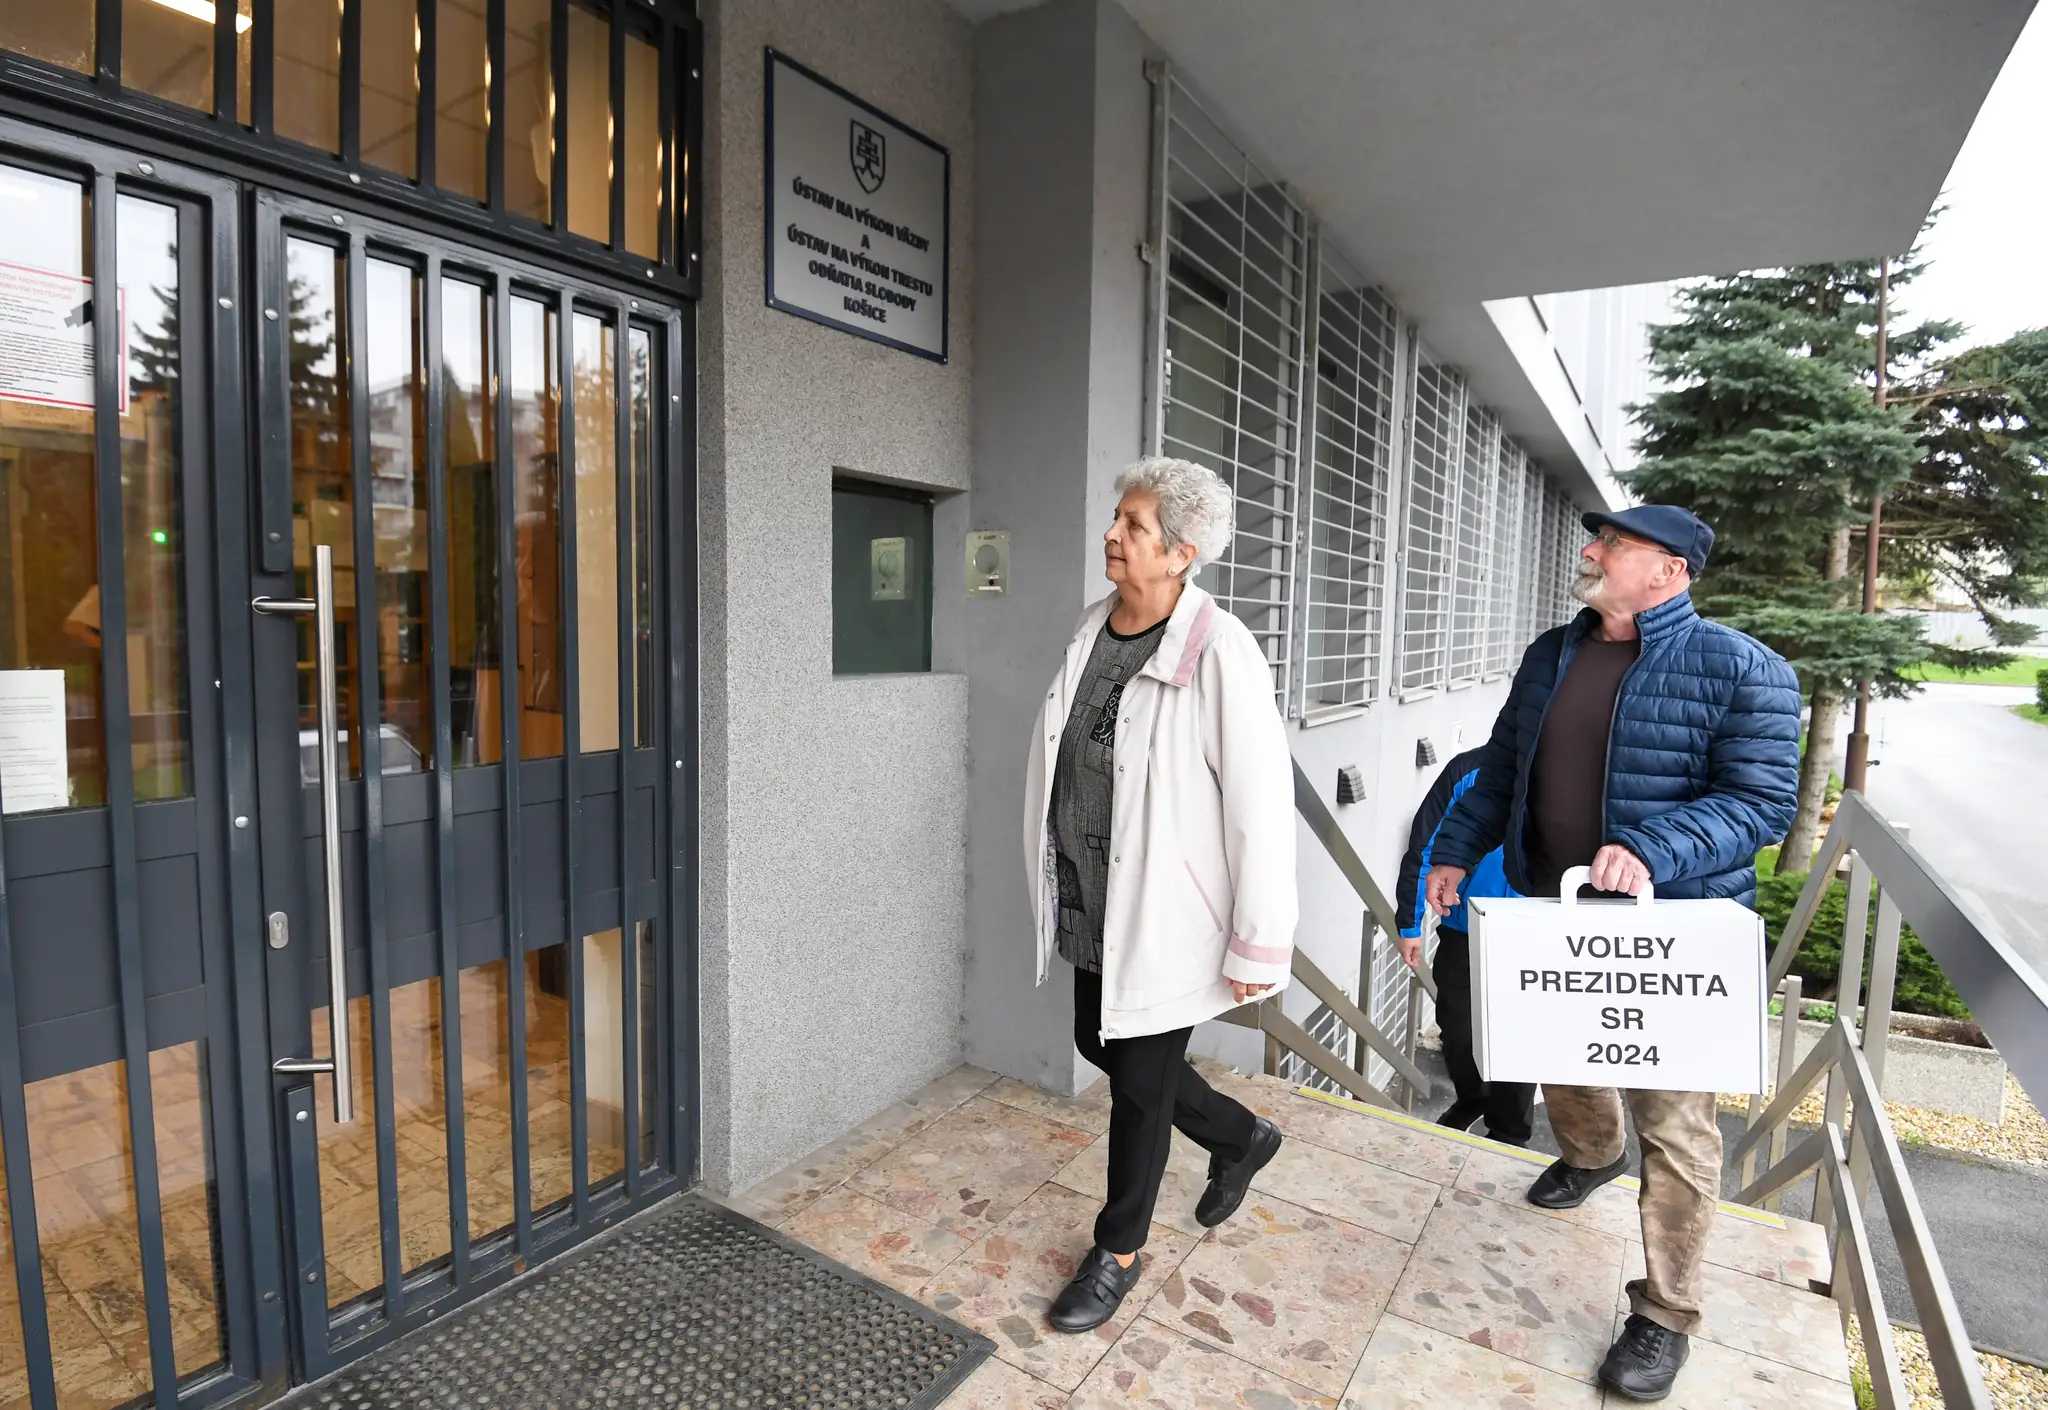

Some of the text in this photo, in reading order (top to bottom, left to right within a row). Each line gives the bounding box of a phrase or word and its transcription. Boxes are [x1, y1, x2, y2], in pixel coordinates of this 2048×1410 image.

[792, 176, 930, 252] ÚSTAV NA VÝKON VÄZBY
[861, 234, 870, 249] A
[787, 223, 933, 296] ÚSTAV NA VÝKON TRESTU
[808, 260, 917, 312] ODŇATIA SLOBODY
[844, 296, 887, 323] KOŠICE
[1566, 936, 1675, 959] VOĽBY
[1520, 970, 1728, 997] PREZIDENTA
[1601, 1007, 1644, 1030] SR
[1587, 1043, 1660, 1066] 2024
